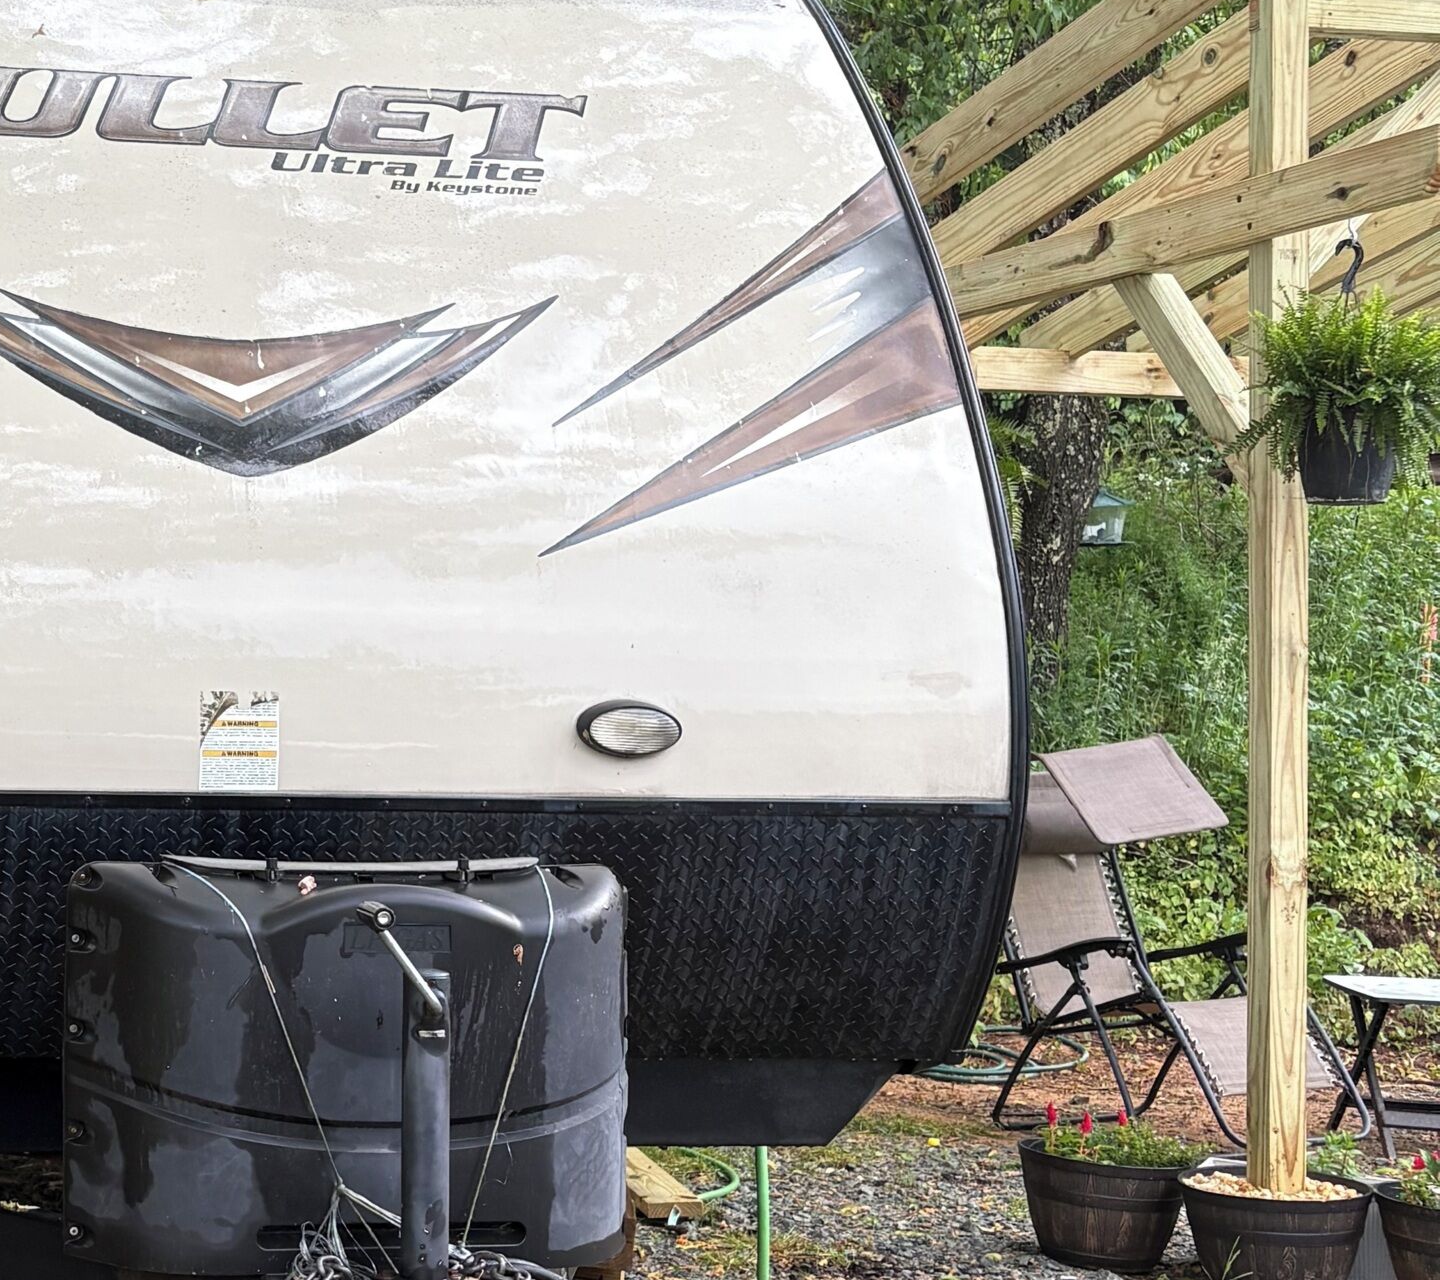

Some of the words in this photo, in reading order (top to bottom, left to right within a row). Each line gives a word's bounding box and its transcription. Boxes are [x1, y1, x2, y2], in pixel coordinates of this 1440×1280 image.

[270, 151, 418, 177] Ultra
[434, 159, 545, 182] Lite
[390, 179, 420, 194] By
[426, 181, 538, 196] Keystone
